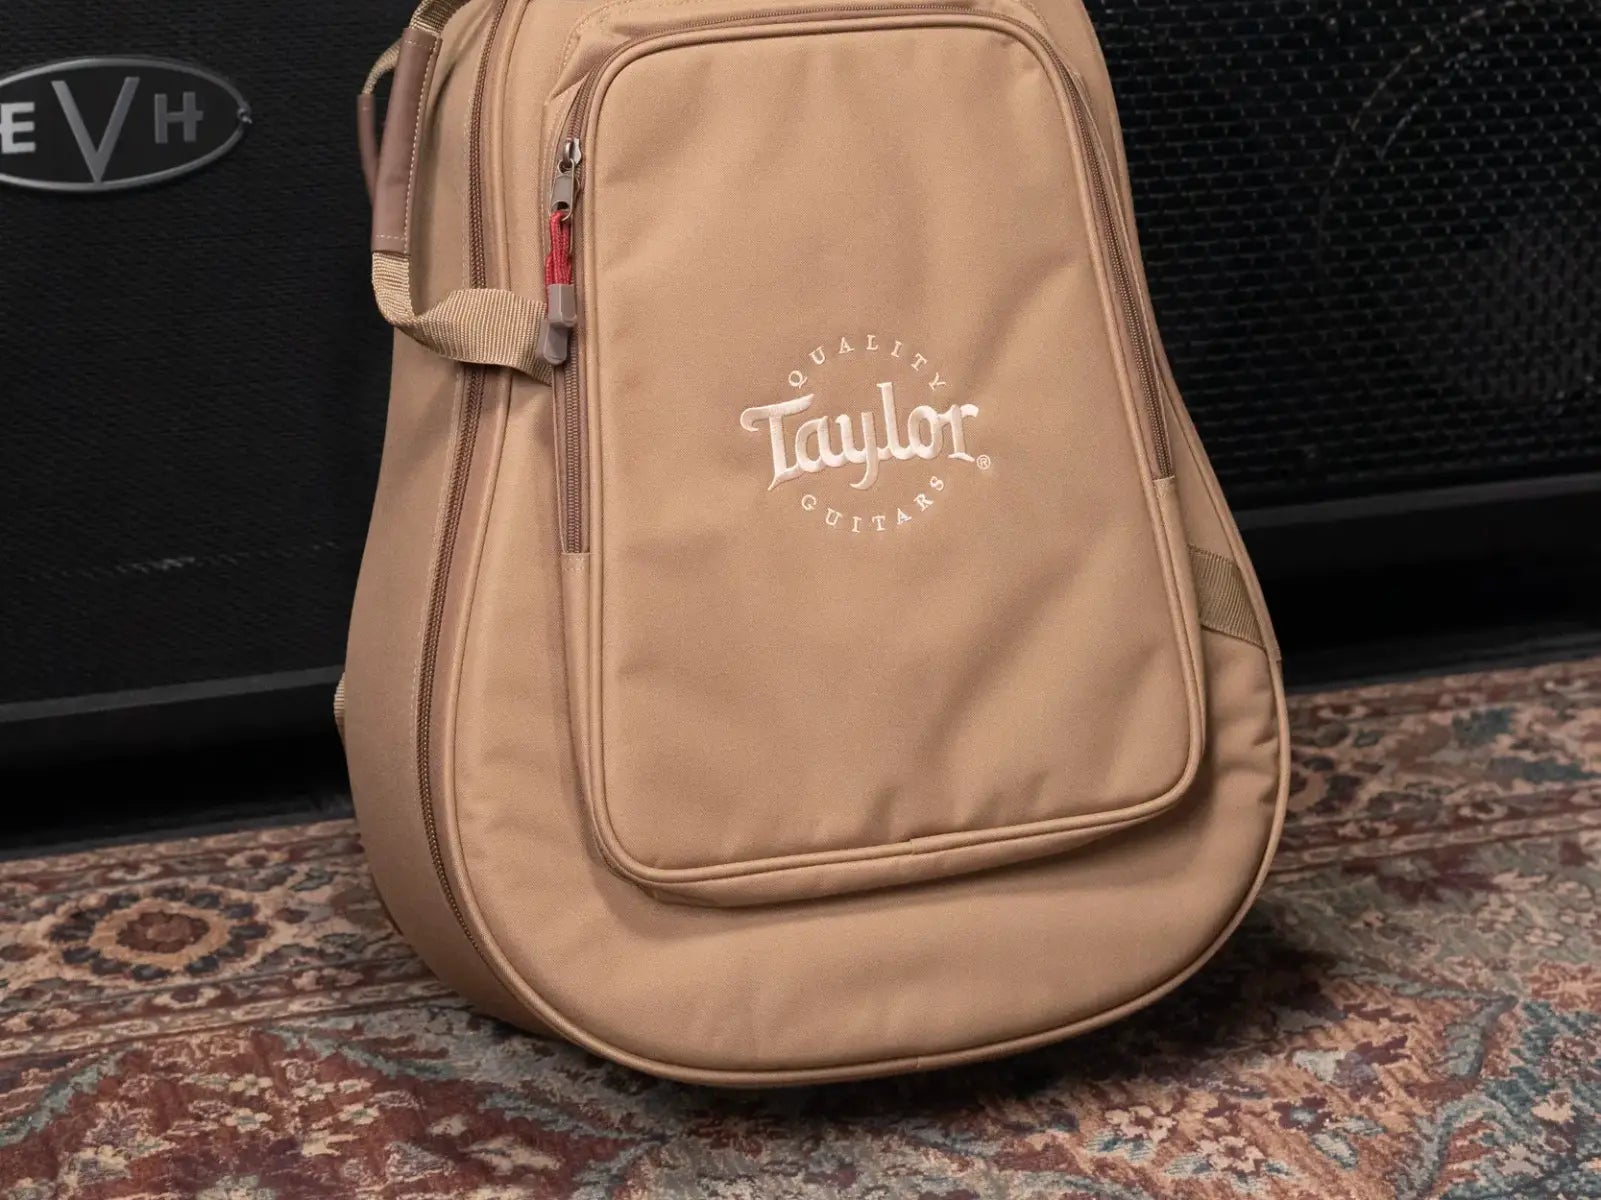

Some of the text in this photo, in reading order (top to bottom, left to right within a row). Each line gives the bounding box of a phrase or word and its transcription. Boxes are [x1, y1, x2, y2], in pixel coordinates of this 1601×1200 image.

[0, 76, 204, 184] EVH
[788, 334, 947, 391] QUALITY
[801, 475, 945, 533] GUITARS
